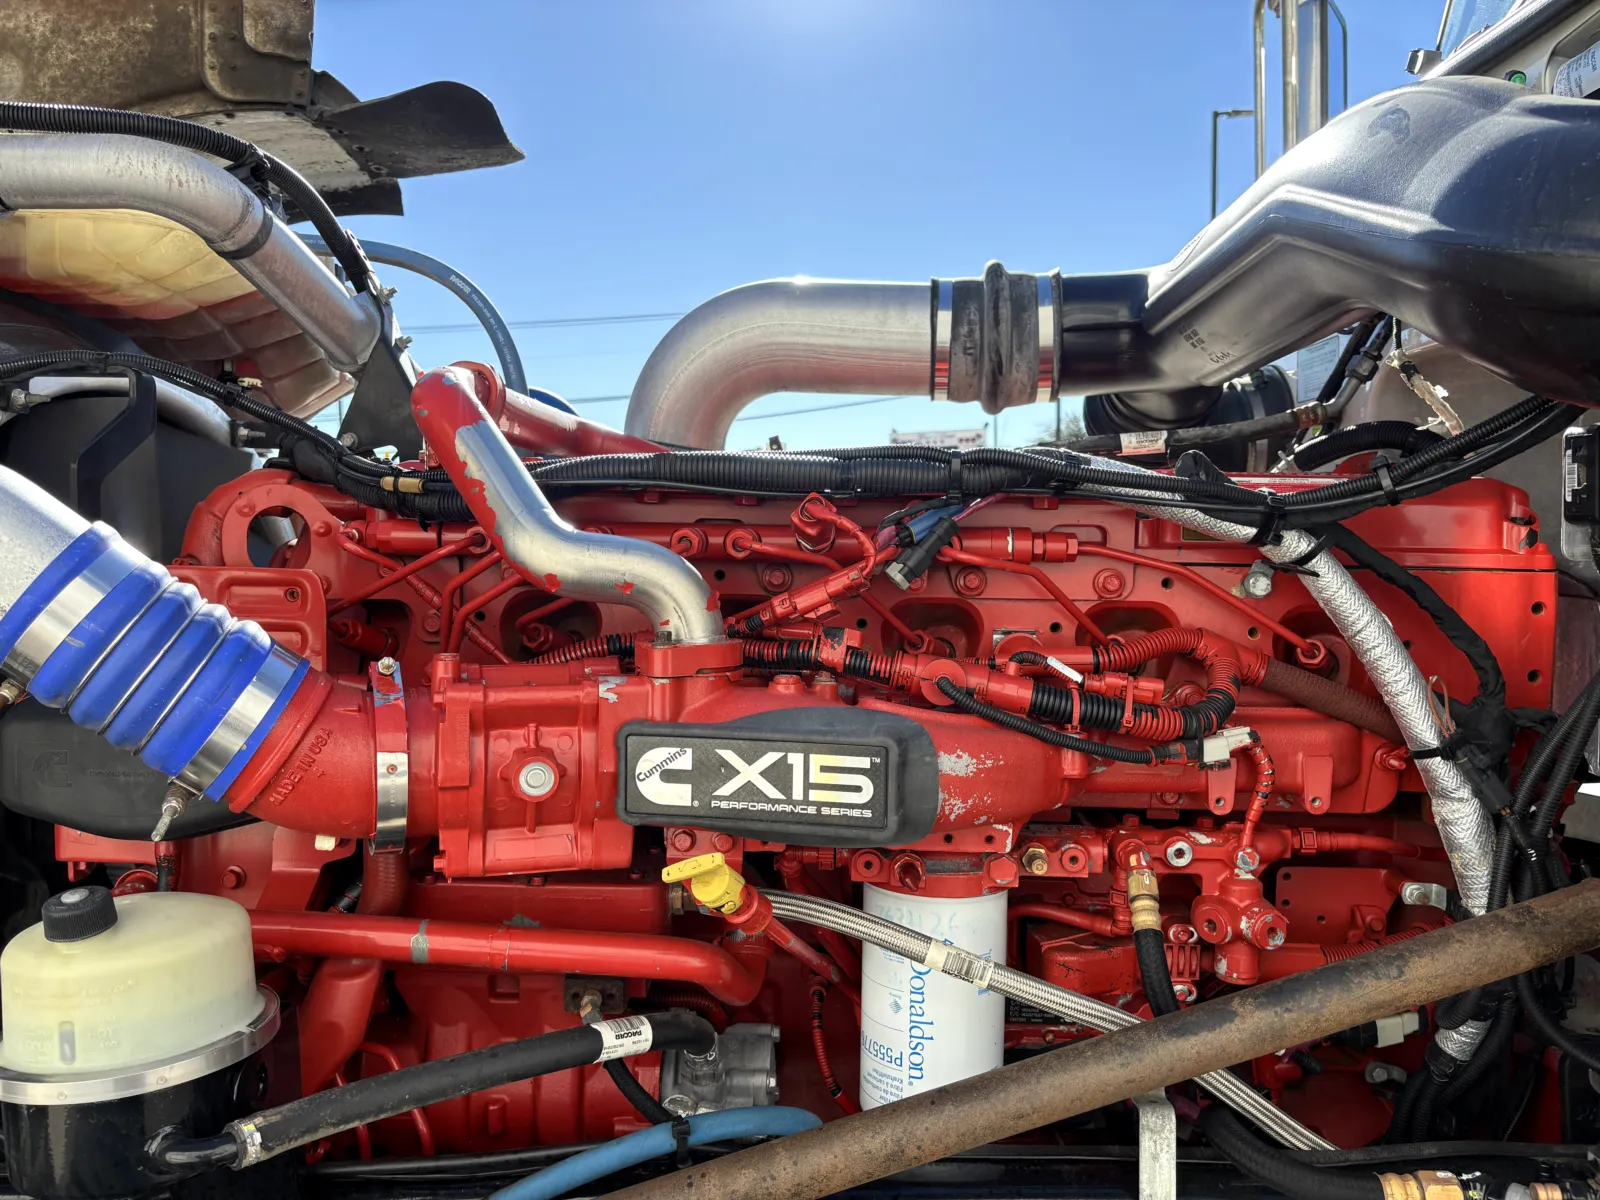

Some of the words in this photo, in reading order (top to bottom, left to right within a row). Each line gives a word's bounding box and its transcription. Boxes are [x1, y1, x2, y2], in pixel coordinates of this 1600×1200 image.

[449, 274, 471, 294] PACCAR
[269, 770, 303, 805] MADE
[295, 753, 316, 772] IN
[308, 728, 333, 755] USA
[636, 748, 687, 782] Cummins
[711, 749, 874, 804] X15
[711, 800, 817, 814] PERFORMANCE
[821, 807, 873, 818] SERIES
[615, 1029, 642, 1040] PACCAR
[908, 960, 934, 1081] Donaldson
